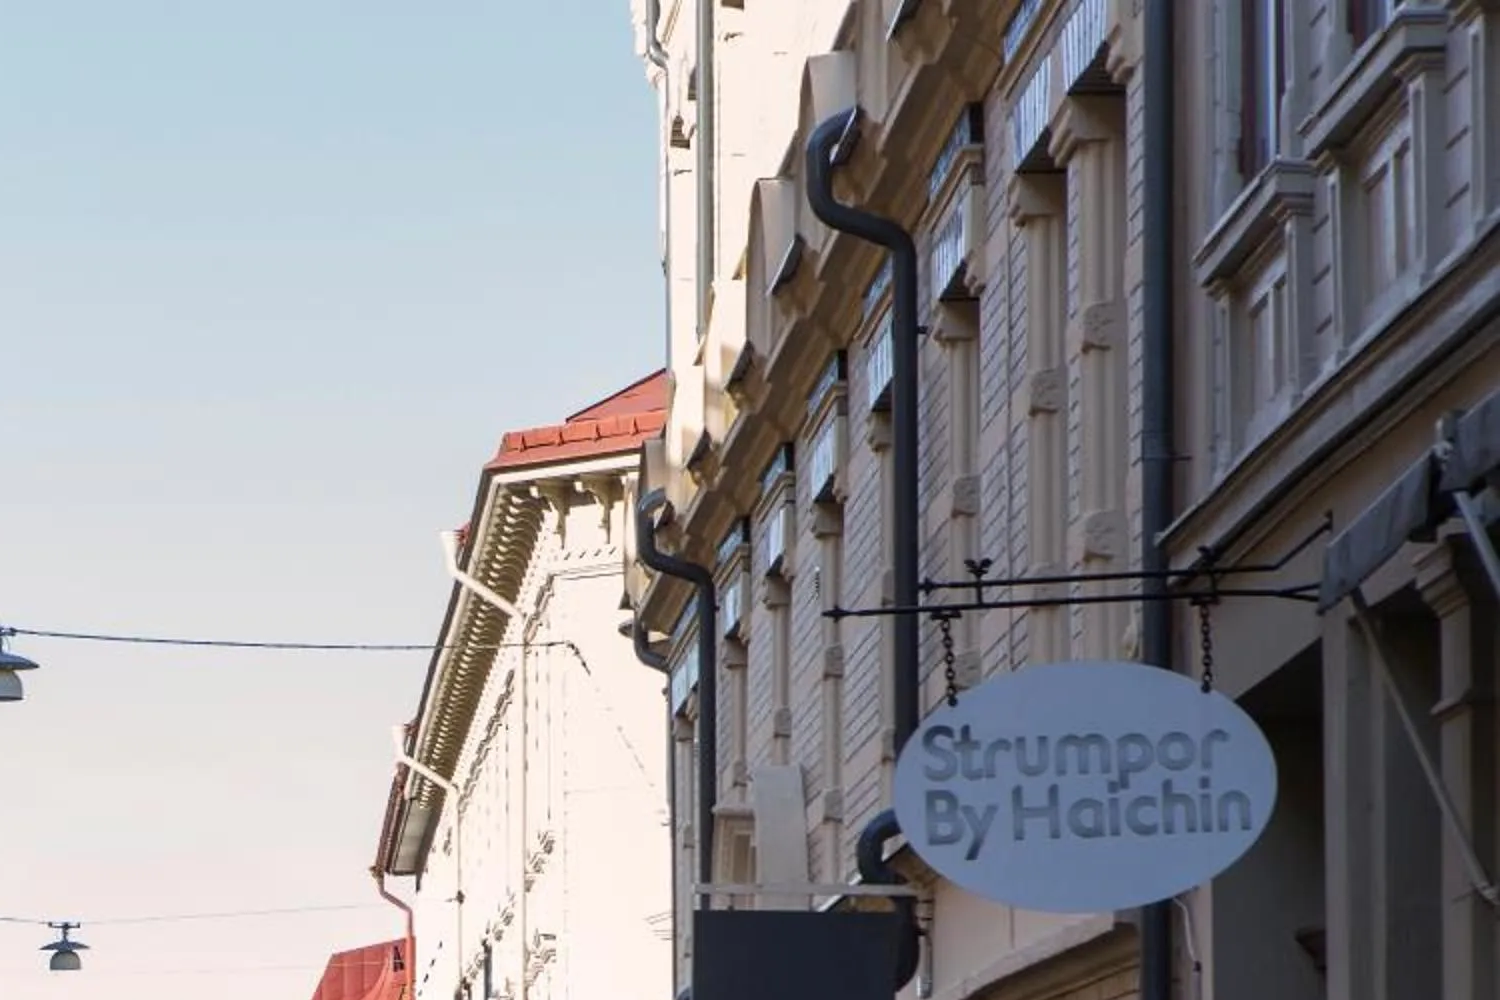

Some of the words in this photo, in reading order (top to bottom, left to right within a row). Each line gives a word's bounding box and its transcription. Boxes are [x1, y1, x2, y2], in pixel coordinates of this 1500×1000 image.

[921, 723, 1230, 790] Strumpor
[924, 789, 998, 861] By
[1011, 777, 1253, 842] Haichin
